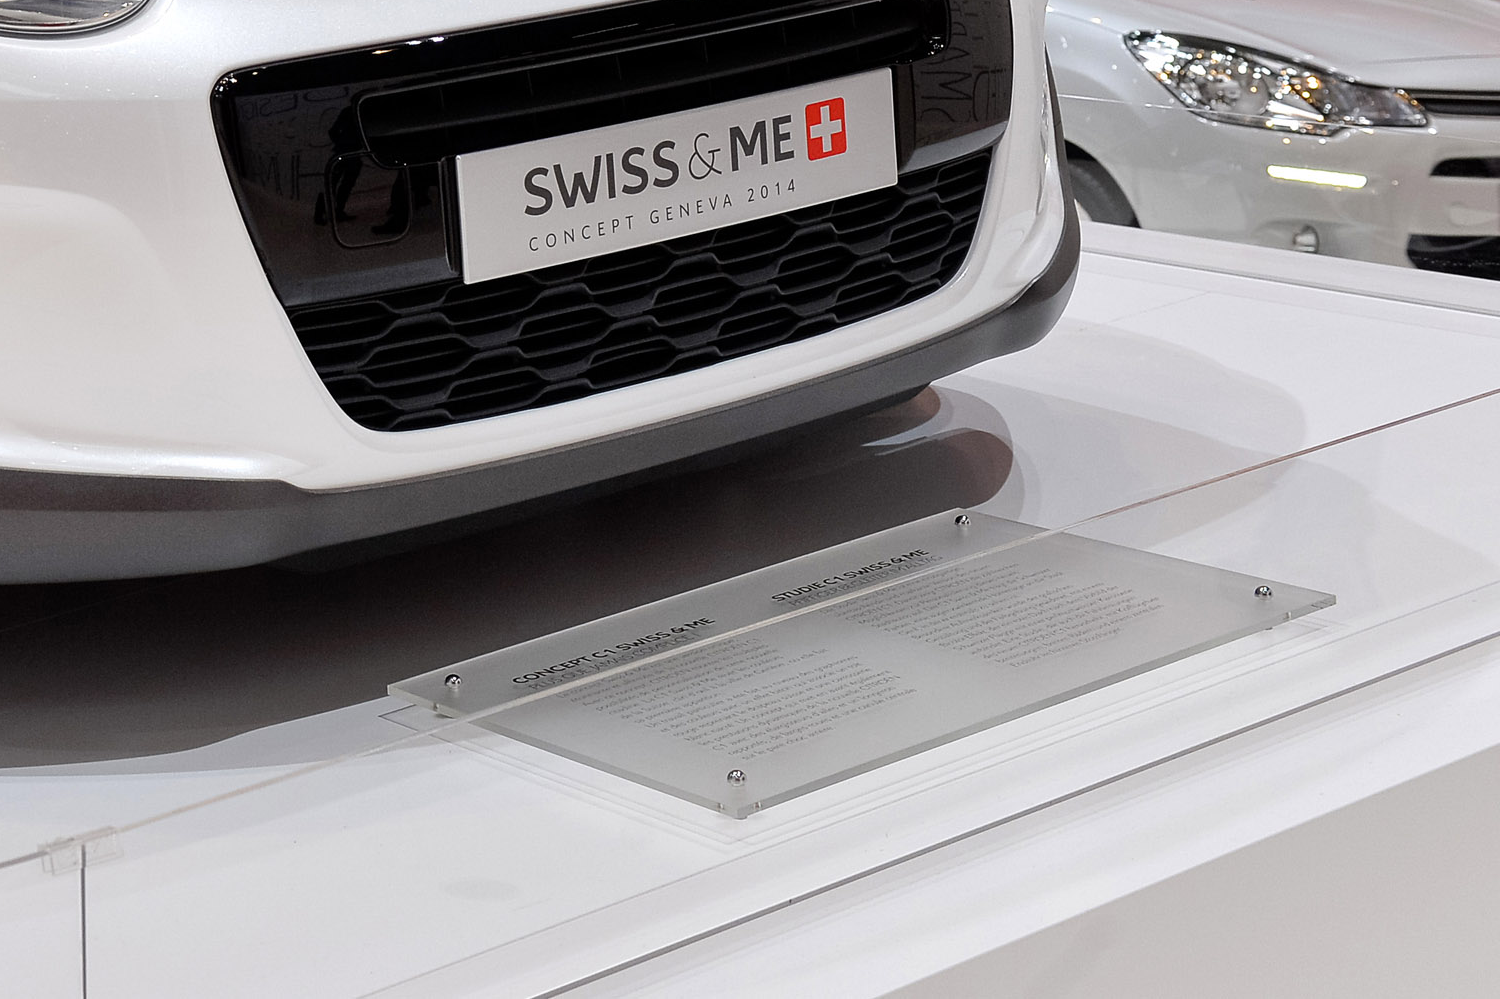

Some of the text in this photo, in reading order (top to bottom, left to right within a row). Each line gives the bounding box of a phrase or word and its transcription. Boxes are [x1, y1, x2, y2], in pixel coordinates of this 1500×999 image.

[523, 139, 680, 216] SWISS
[728, 114, 795, 172] ME
[528, 178, 796, 252] CONCEPT GENEVA 2014
[771, 581, 827, 602] STUDIE
[823, 576, 845, 586] C1
[843, 560, 892, 579] SWISS
[901, 548, 929, 561] ME
[512, 655, 592, 684] CONCEPT
[591, 648, 618, 659] C1
[615, 631, 671, 651] SWISS
[684, 617, 716, 631] ME
